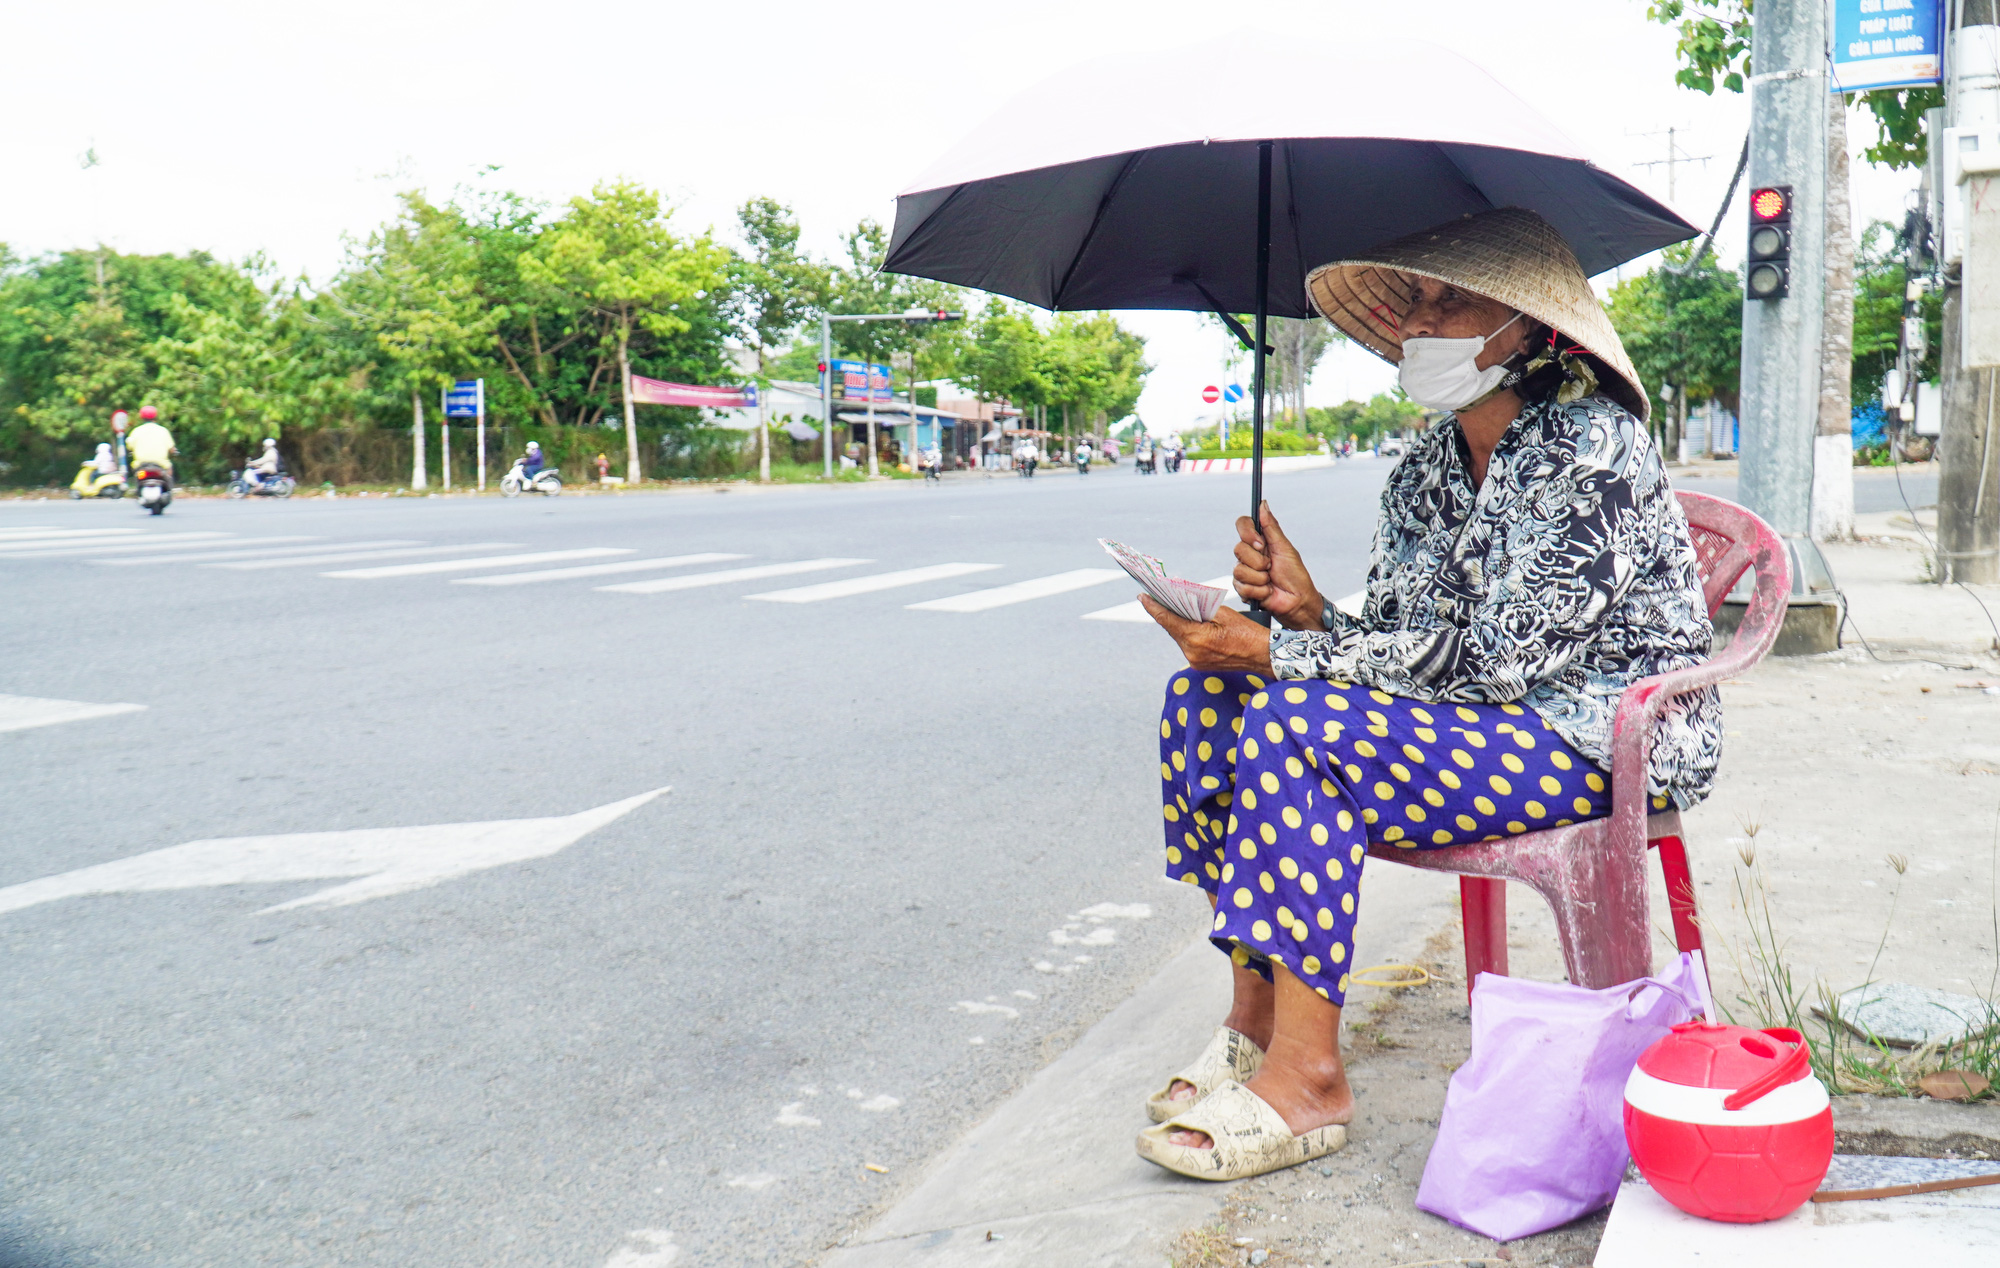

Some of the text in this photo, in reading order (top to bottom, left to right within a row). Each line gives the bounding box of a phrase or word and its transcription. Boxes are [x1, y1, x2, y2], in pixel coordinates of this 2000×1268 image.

[1860, 14, 1914, 35] PHÁP LUẬT
[1849, 39, 1871, 57] CỦA
[1872, 37, 1894, 55] NHÀ
